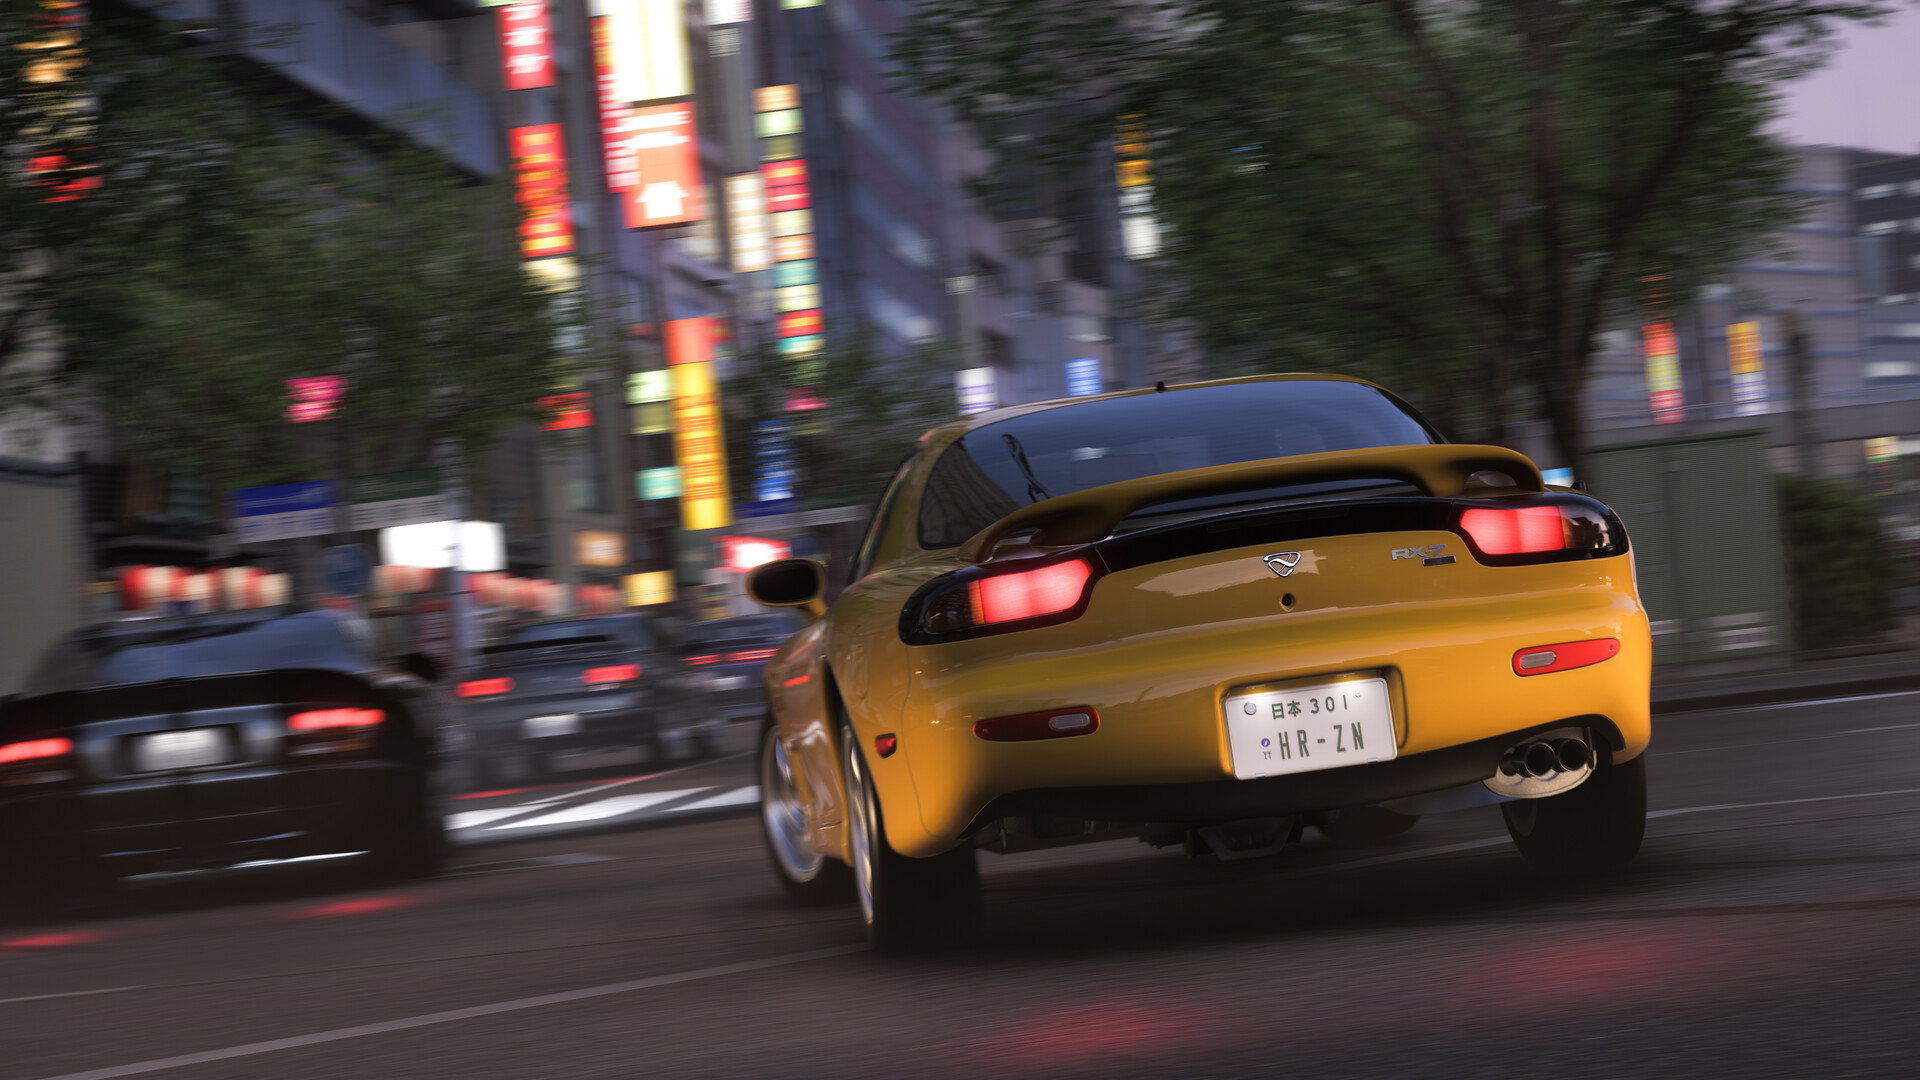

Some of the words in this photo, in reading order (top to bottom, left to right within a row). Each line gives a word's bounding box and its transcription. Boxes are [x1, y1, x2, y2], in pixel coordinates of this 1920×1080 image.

[1391, 543, 1447, 561] RX-7
[1271, 700, 1302, 720] 日本
[1309, 694, 1348, 714] 301
[1278, 721, 1365, 760] HR-ZN
